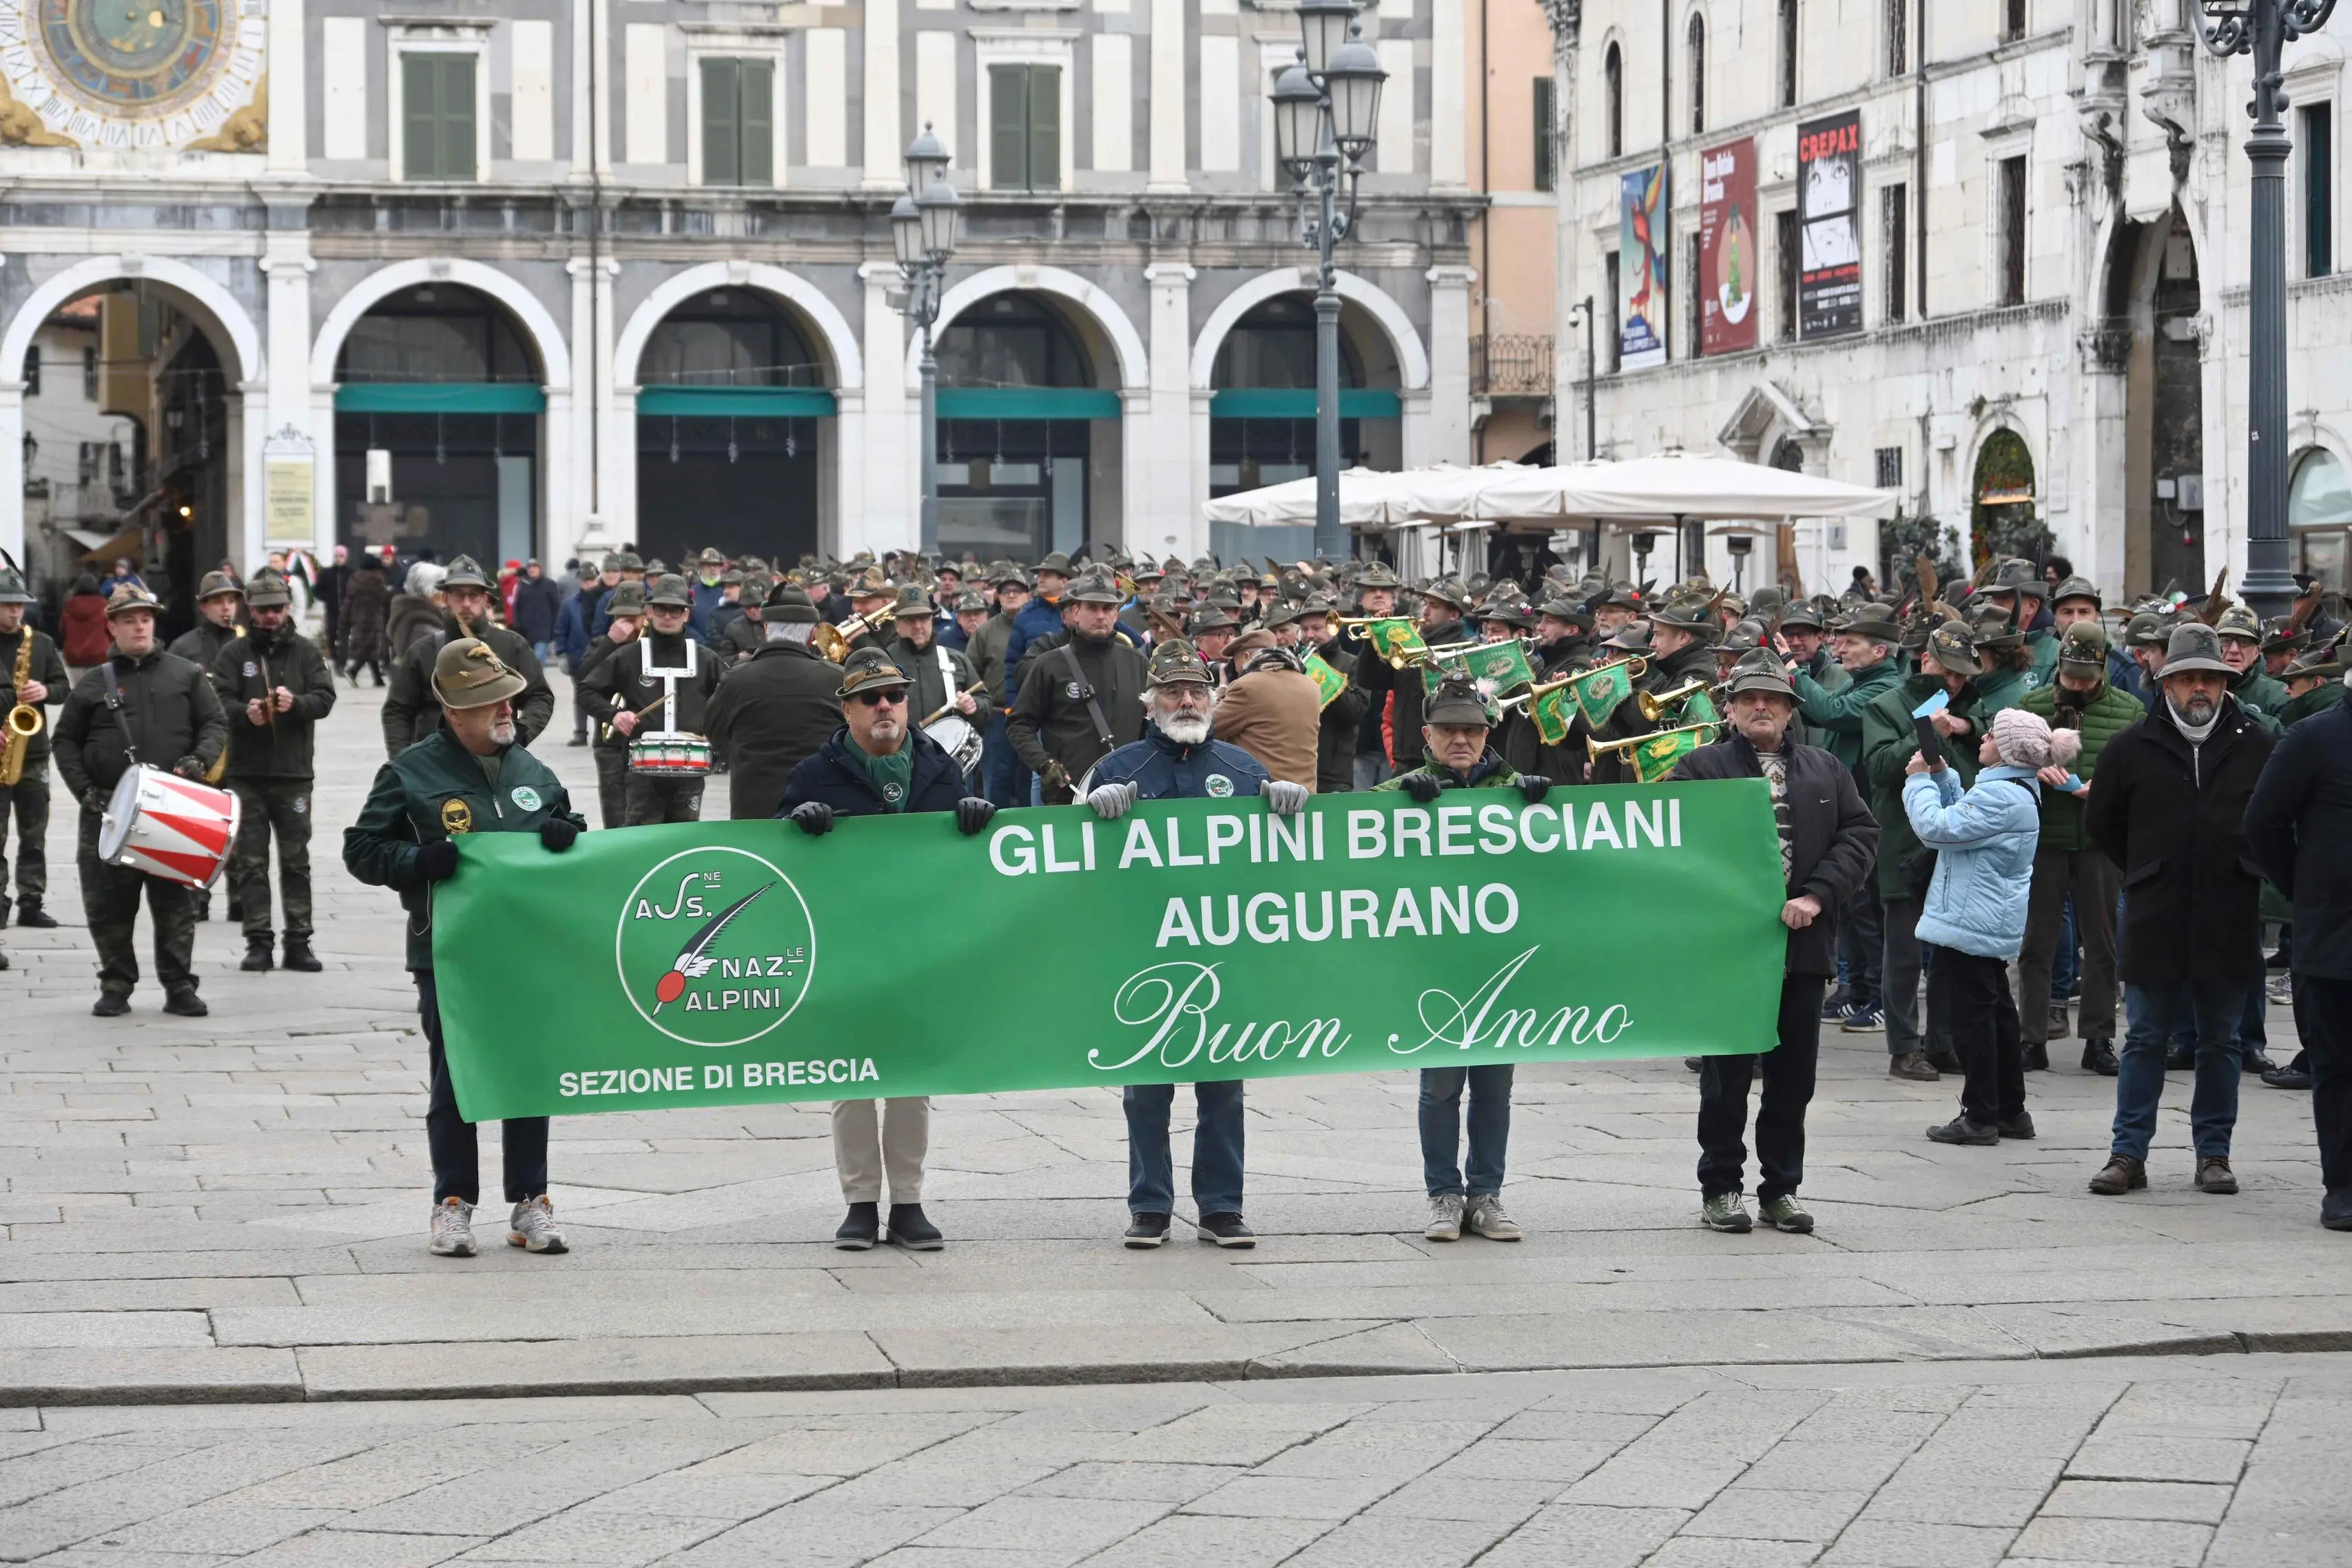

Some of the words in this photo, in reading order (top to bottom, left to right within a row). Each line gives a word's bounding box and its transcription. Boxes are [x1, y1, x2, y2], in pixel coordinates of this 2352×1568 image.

[1800, 124, 1858, 163] CREPAX
[989, 822, 1095, 876] GLI
[1118, 811, 1324, 869] ALPINI
[1348, 799, 1682, 859] BRESCIANI
[1155, 883, 1519, 948] AUGURANO
[684, 987, 781, 1012] ALPINI
[1087, 961, 1352, 1069] Buon
[1388, 945, 1633, 1054] Anno
[559, 1068, 694, 1097] SEZIONE
[704, 1064, 733, 1089] DI
[743, 1058, 880, 1086] BRESCIA
